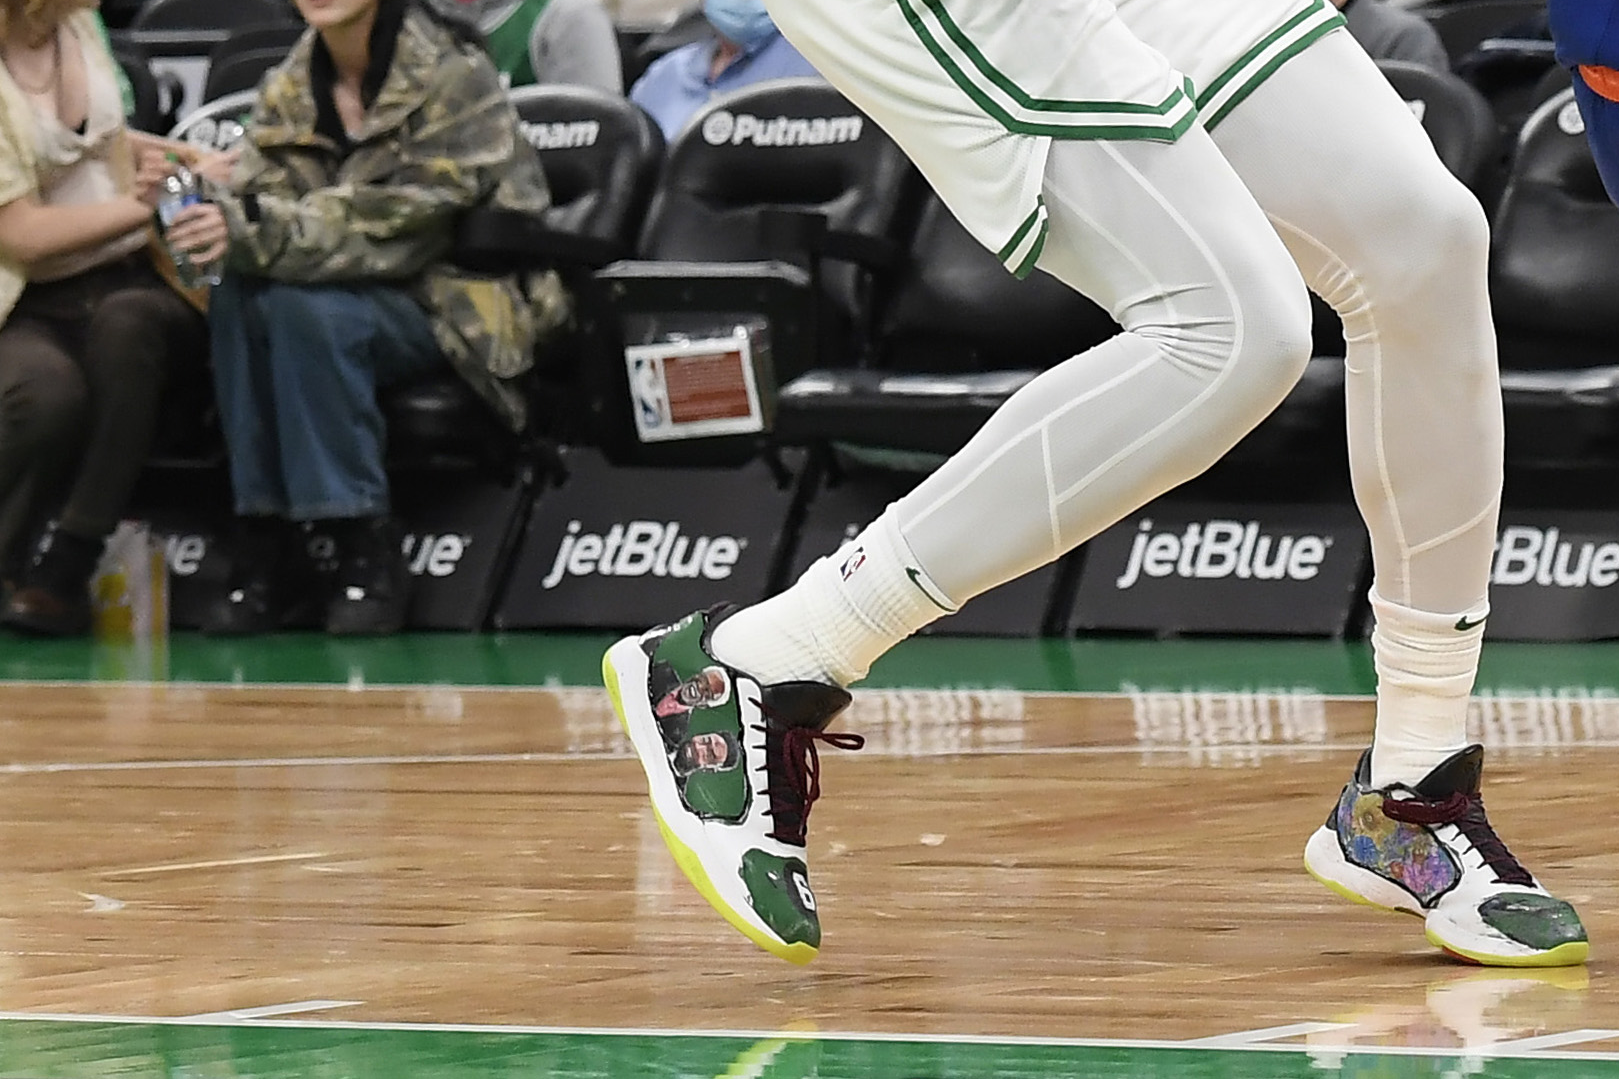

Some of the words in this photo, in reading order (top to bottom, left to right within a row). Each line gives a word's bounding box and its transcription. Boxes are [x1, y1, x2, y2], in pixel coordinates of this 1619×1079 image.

[519, 120, 600, 150] nam
[733, 114, 863, 146] Putnam
[541, 519, 742, 589] jetBlue
[1116, 518, 1326, 589] jetBlue
[792, 871, 816, 913] 6
